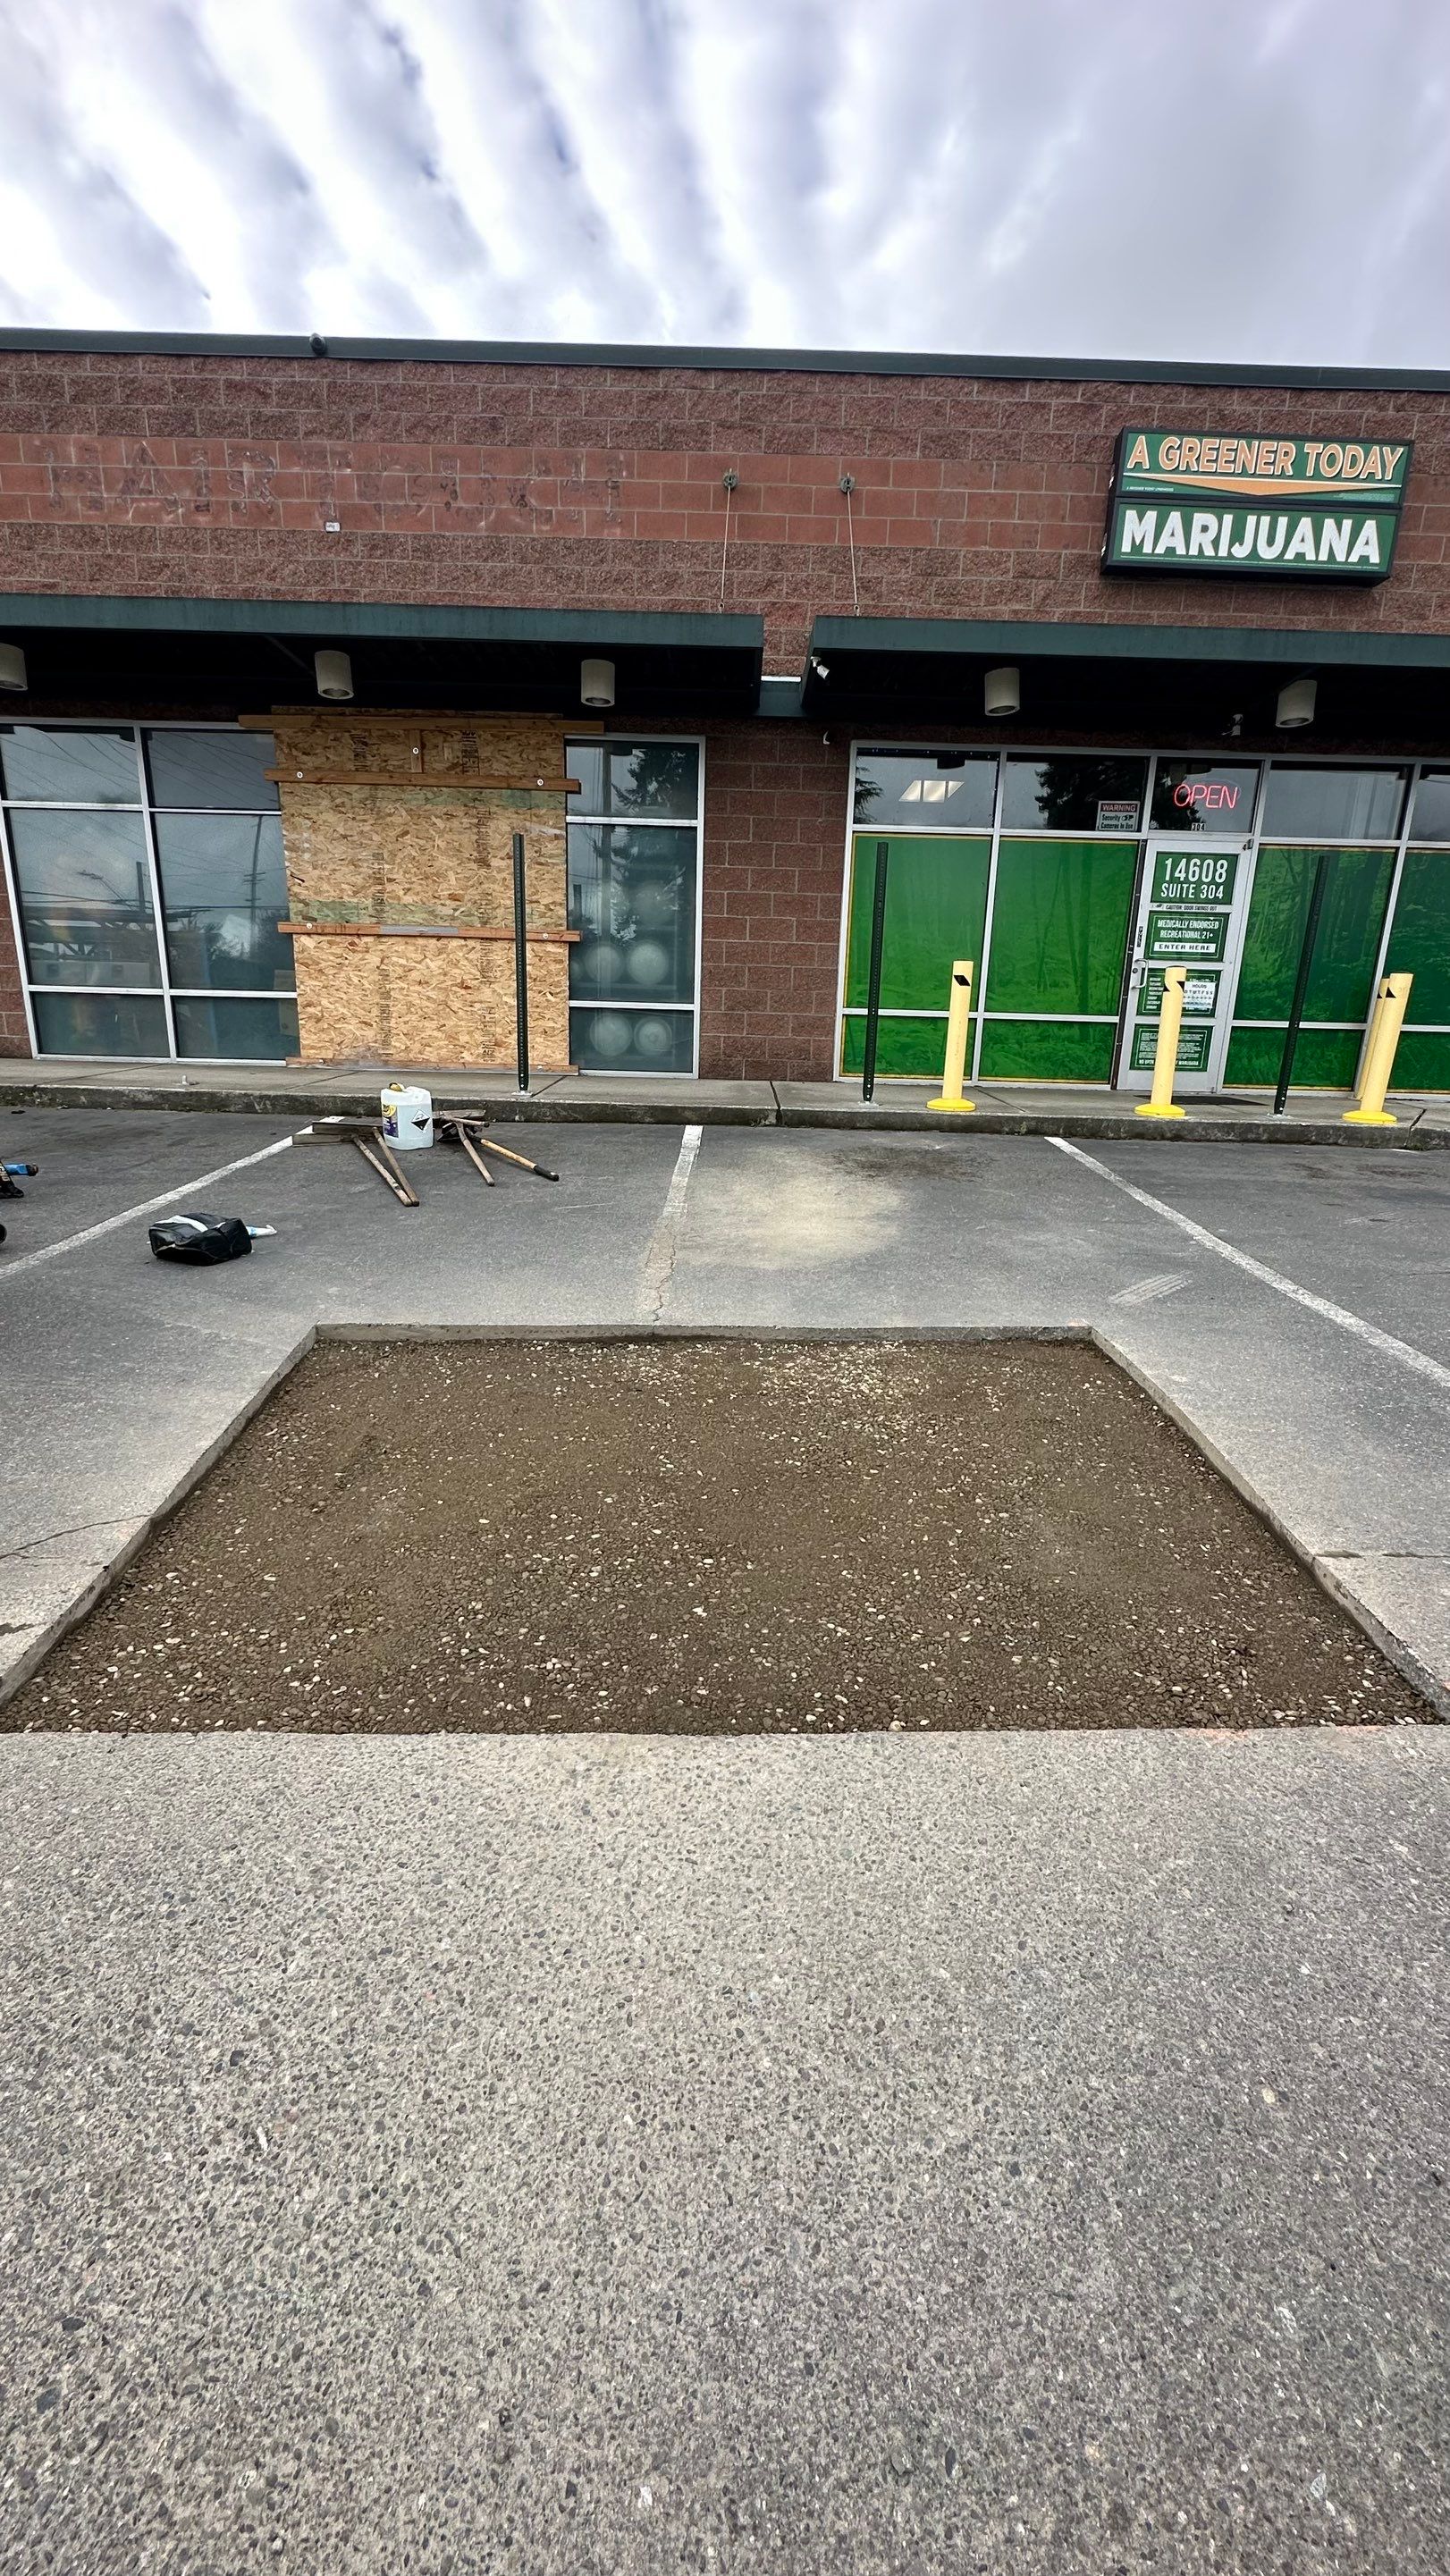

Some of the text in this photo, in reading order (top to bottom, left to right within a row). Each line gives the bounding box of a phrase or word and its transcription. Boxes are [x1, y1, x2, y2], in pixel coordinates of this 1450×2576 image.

[1126, 435, 1404, 480] A GREENER TODAY
[1121, 509, 1381, 564] MARIJUANA
[1174, 783, 1239, 810] OPEN
[1102, 814, 1121, 822] Security
[1192, 823, 1206, 831] 304
[1165, 858, 1228, 883] 14608
[1160, 883, 1224, 899] SUITE 304
[1158, 920, 1219, 930] MEDICALLY ENDORSED
[1160, 930, 1214, 939] RECREATIONAL 21+
